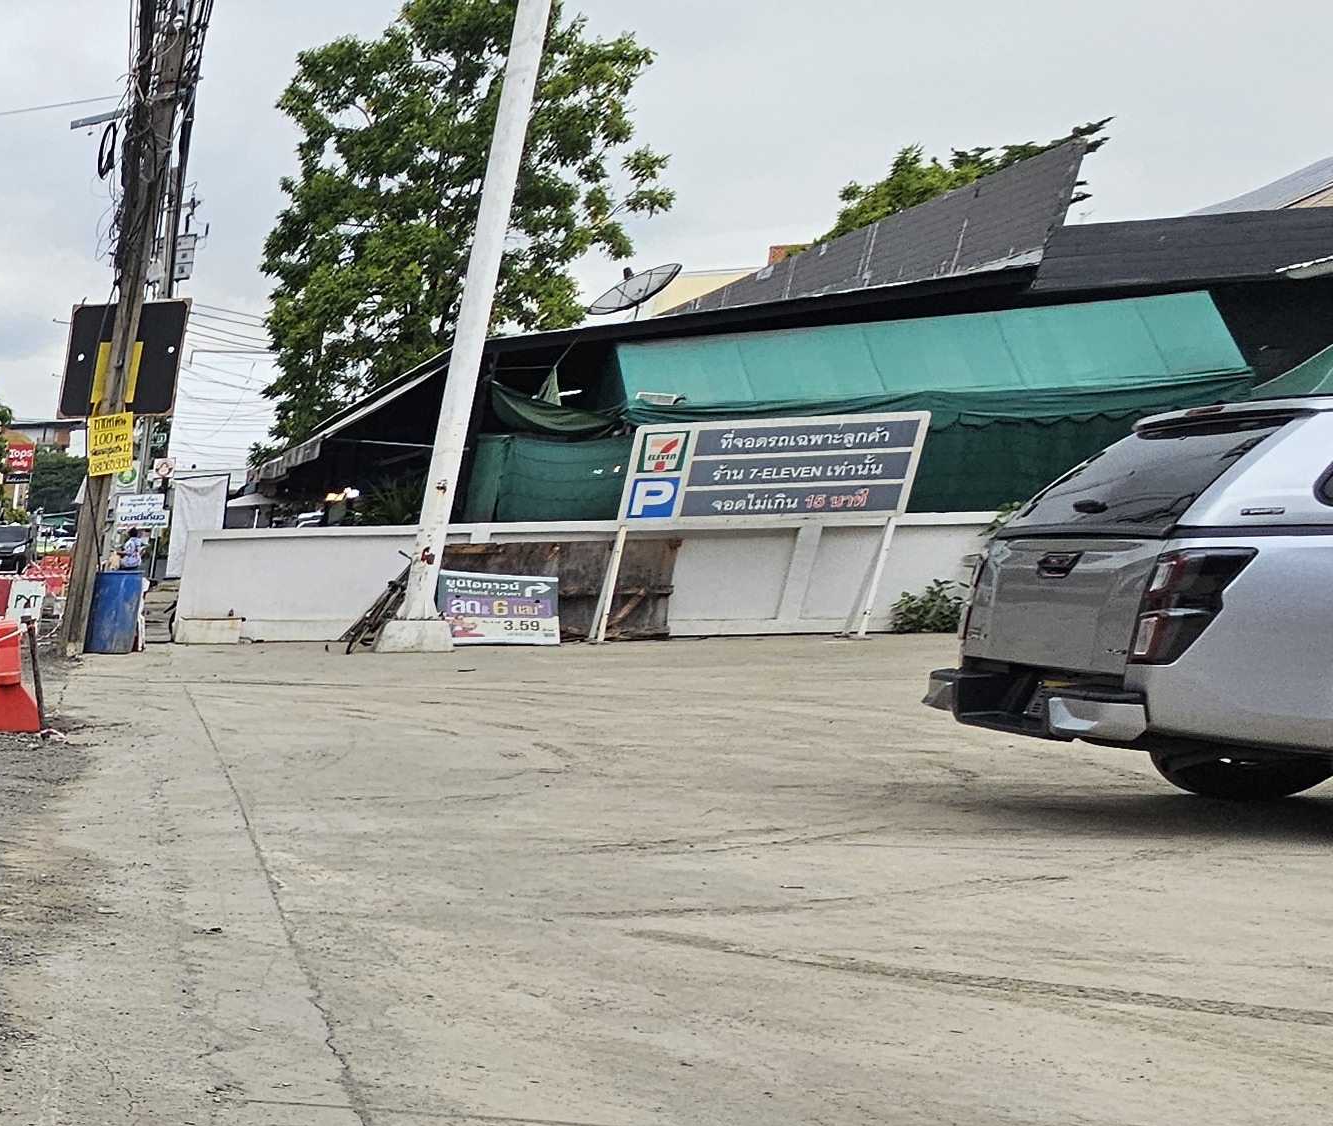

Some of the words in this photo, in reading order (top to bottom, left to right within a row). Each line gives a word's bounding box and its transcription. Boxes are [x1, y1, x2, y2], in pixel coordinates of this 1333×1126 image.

[93, 433, 113, 447] 100
[720, 428, 891, 450] ที่จอดรถเฉพาะลูกค้า
[712, 463, 745, 482] ร้าน
[749, 465, 823, 480] 7-ELEVEN
[826, 455, 884, 478] เท่านั้น
[630, 480, 675, 517] P
[711, 493, 799, 512] จอดไม่เกิน
[805, 493, 827, 509] 15
[830, 488, 870, 509] นาที
[445, 578, 521, 592] ยูนิโอทาวน์
[451, 599, 481, 615] ลด
[493, 600, 509, 616] 6
[503, 620, 540, 631] 3.59
